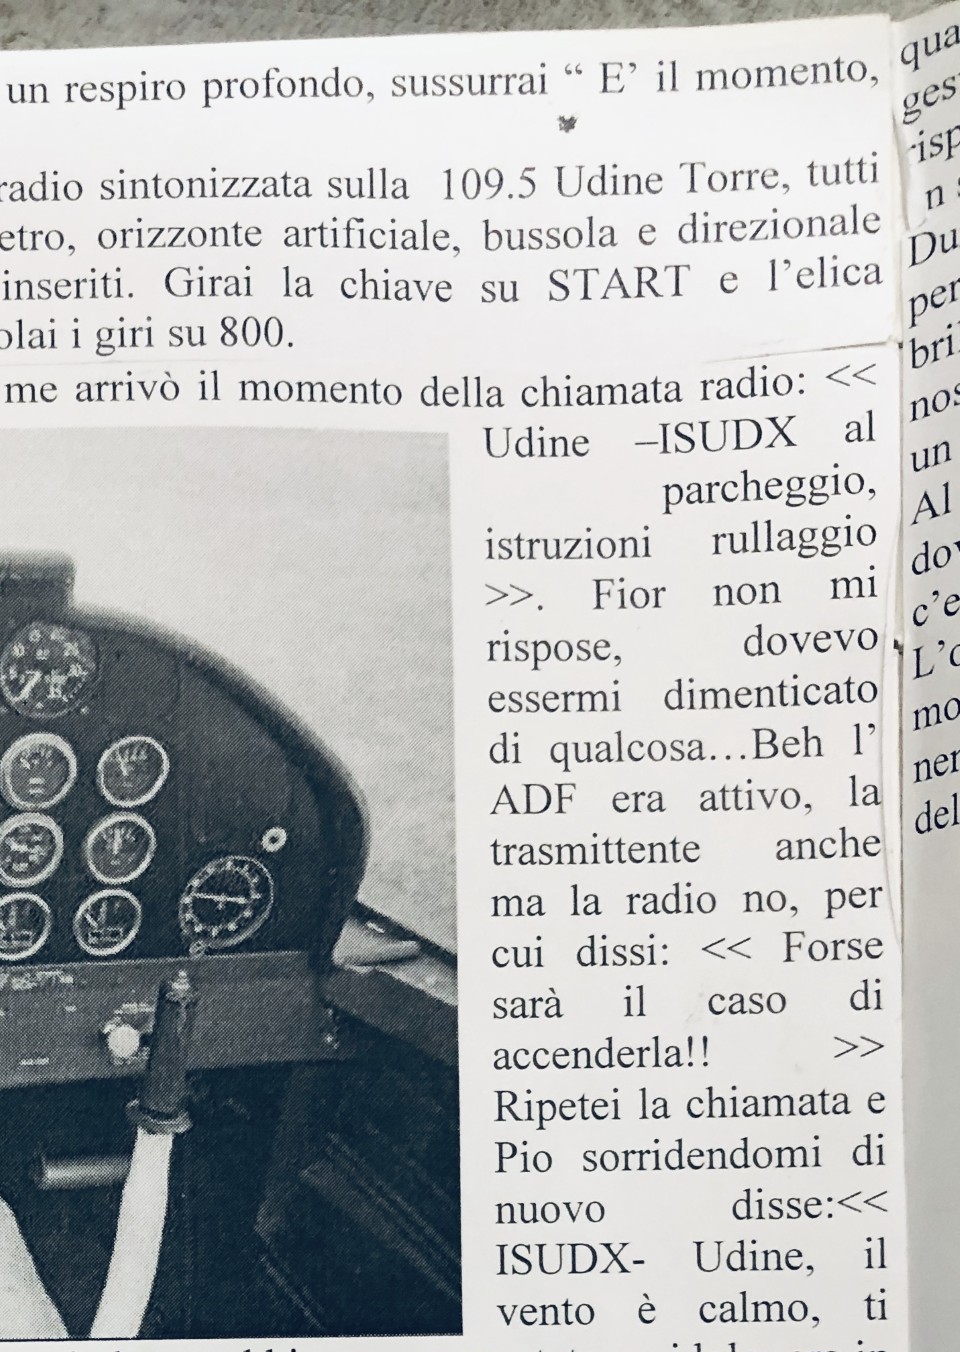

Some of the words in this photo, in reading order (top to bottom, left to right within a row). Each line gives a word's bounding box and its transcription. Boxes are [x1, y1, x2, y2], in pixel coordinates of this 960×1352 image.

[6, 82, 50, 105] un
[64, 70, 186, 111] respiro
[201, 66, 375, 109] profondo,
[391, 62, 548, 98] sussurrai
[656, 59, 679, 93] il
[696, 56, 879, 92] momento,
[100, 166, 313, 201] sintonizzata
[327, 166, 410, 200] sulla
[443, 166, 536, 201] 109.5
[555, 163, 663, 198] Udine
[679, 161, 791, 195] Torre,
[806, 151, 878, 188] tutti
[71, 317, 82, 349] i
[95, 315, 154, 357] giri
[168, 325, 208, 348] su
[220, 315, 294, 348] 800.
[909, 440, 952, 473] un
[661, 462, 876, 516] parcheggio,
[909, 481, 952, 526] Al
[485, 524, 652, 561] istruzioni
[711, 513, 877, 559] rullaggio
[486, 628, 622, 672] rispose,
[743, 623, 879, 658] dovevo
[487, 679, 622, 714] essermi
[663, 673, 879, 711] dimenticato
[489, 782, 577, 815] ADF
[611, 790, 667, 814] era
[699, 778, 813, 815] attivo,
[848, 774, 883, 807] la
[489, 832, 701, 867] trasmittente
[775, 826, 881, 861] anche
[490, 894, 547, 918] ma
[570, 883, 603, 917] la
[625, 881, 717, 915] radio
[742, 889, 799, 918] no,
[823, 886, 884, 920] per
[492, 986, 565, 1020] sarà
[623, 984, 647, 1018] il
[707, 991, 787, 1016] caso
[849, 977, 883, 1012] di
[493, 1087, 622, 1131] Ripetei
[638, 1086, 672, 1120] la
[686, 1084, 852, 1119] chiamata
[867, 1091, 886, 1115] e
[494, 1140, 553, 1174] Pio
[582, 1134, 822, 1173] sorridendomi
[851, 1132, 886, 1167] di
[495, 1241, 646, 1276] ISUDX-
[692, 1238, 815, 1277] Udine,
[864, 1236, 888, 1270] il
[496, 1297, 596, 1327] vento
[637, 1292, 656, 1325] è
[698, 1290, 820, 1329] calmo,
[863, 1287, 888, 1321] ti
